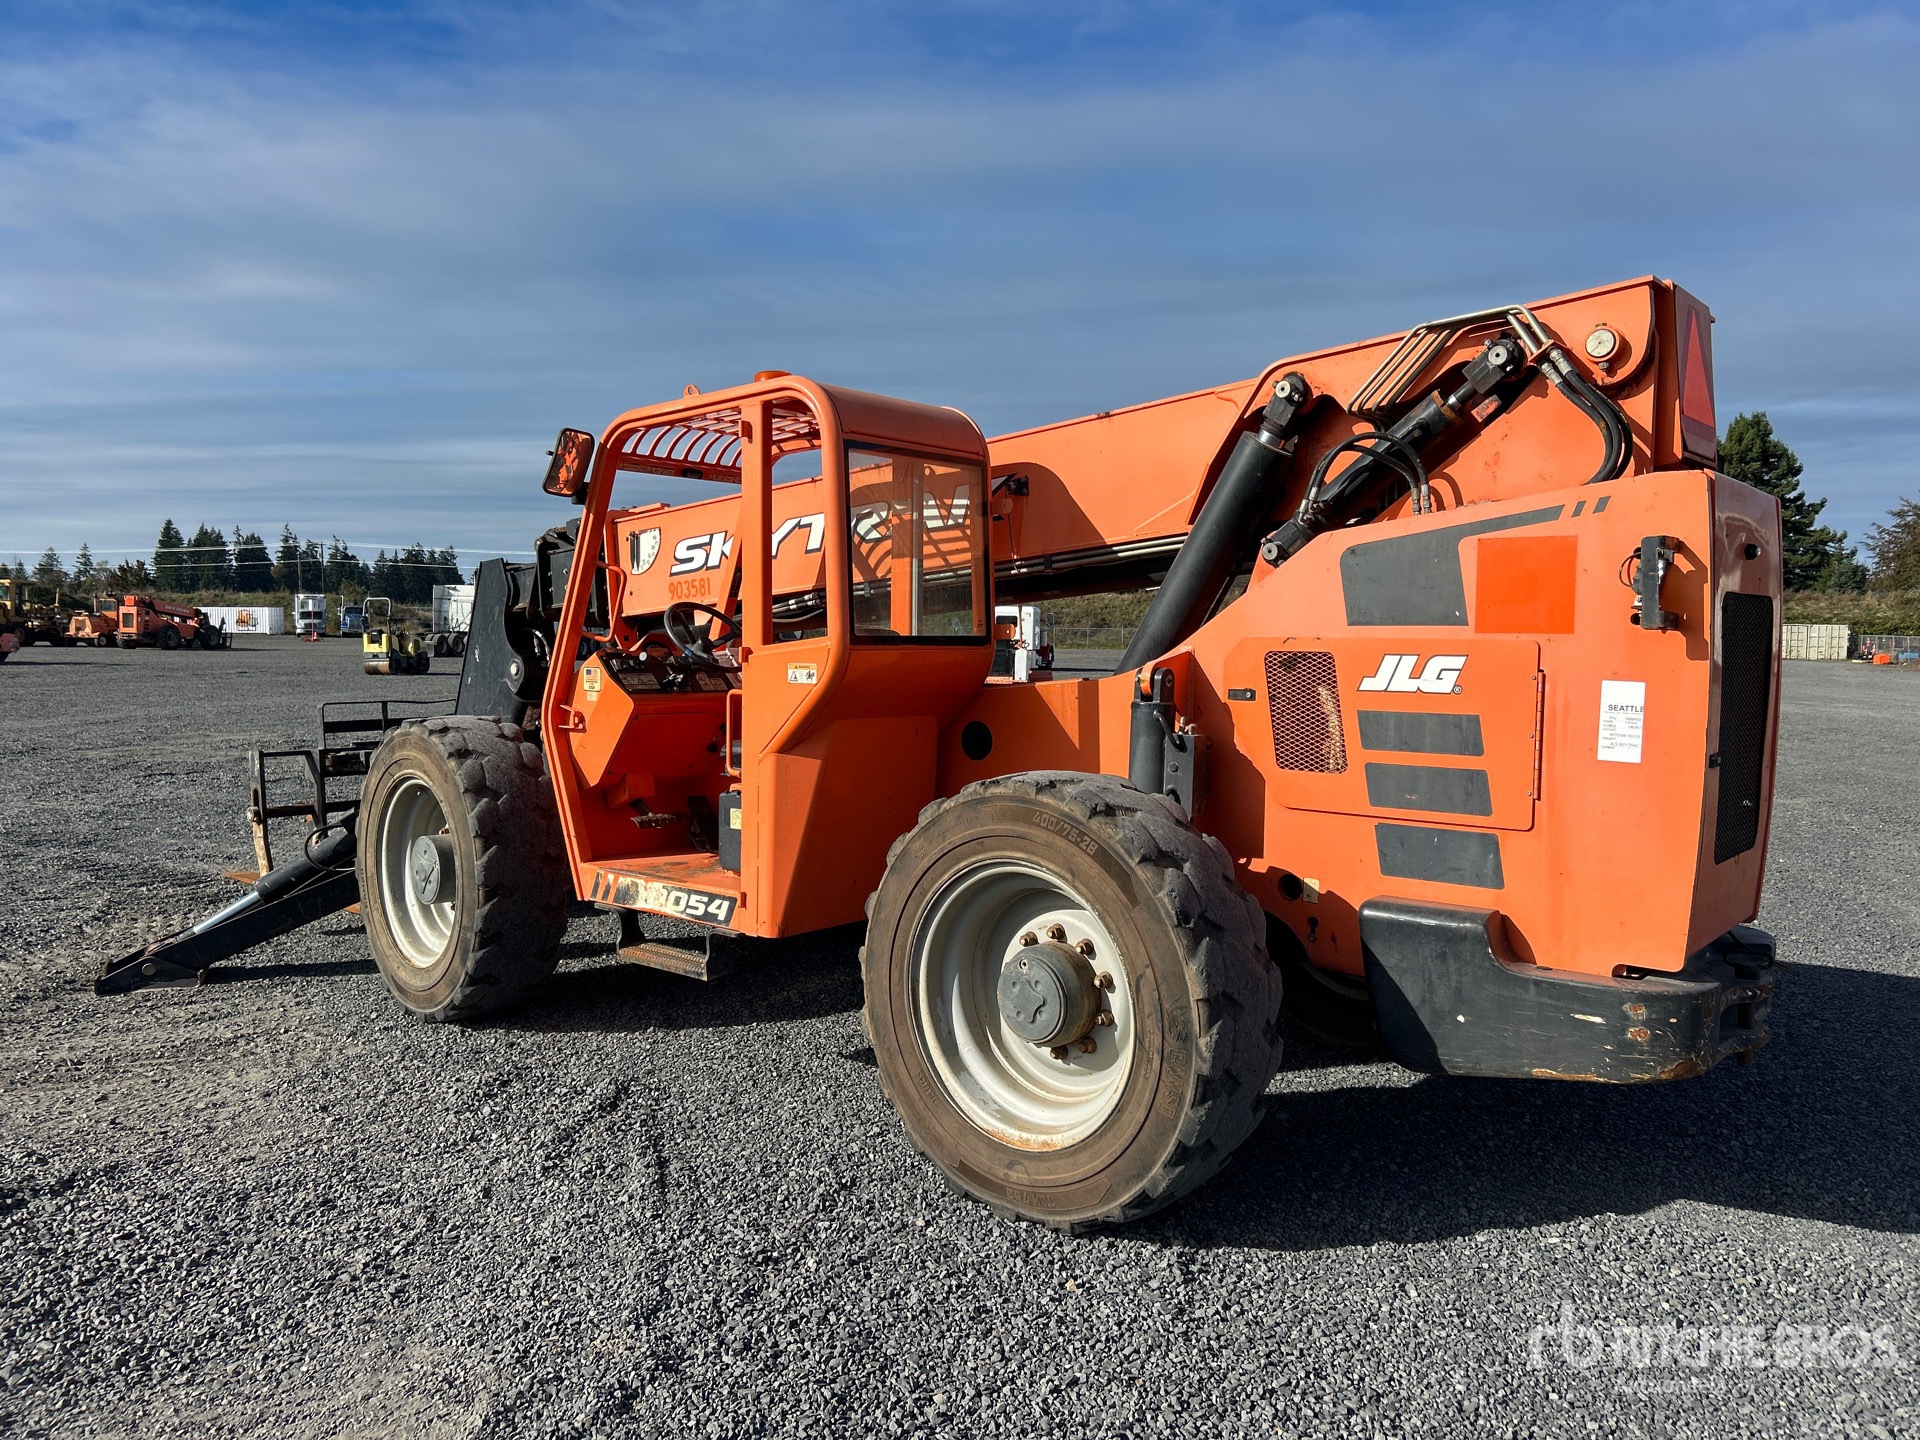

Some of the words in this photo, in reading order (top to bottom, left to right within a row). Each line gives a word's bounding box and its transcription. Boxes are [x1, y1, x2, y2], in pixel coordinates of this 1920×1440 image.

[668, 577, 711, 600] 903581
[1356, 653, 1469, 695] JLG
[1608, 704, 1645, 713] SEATTLE
[1032, 811, 1098, 856] 400/75-28
